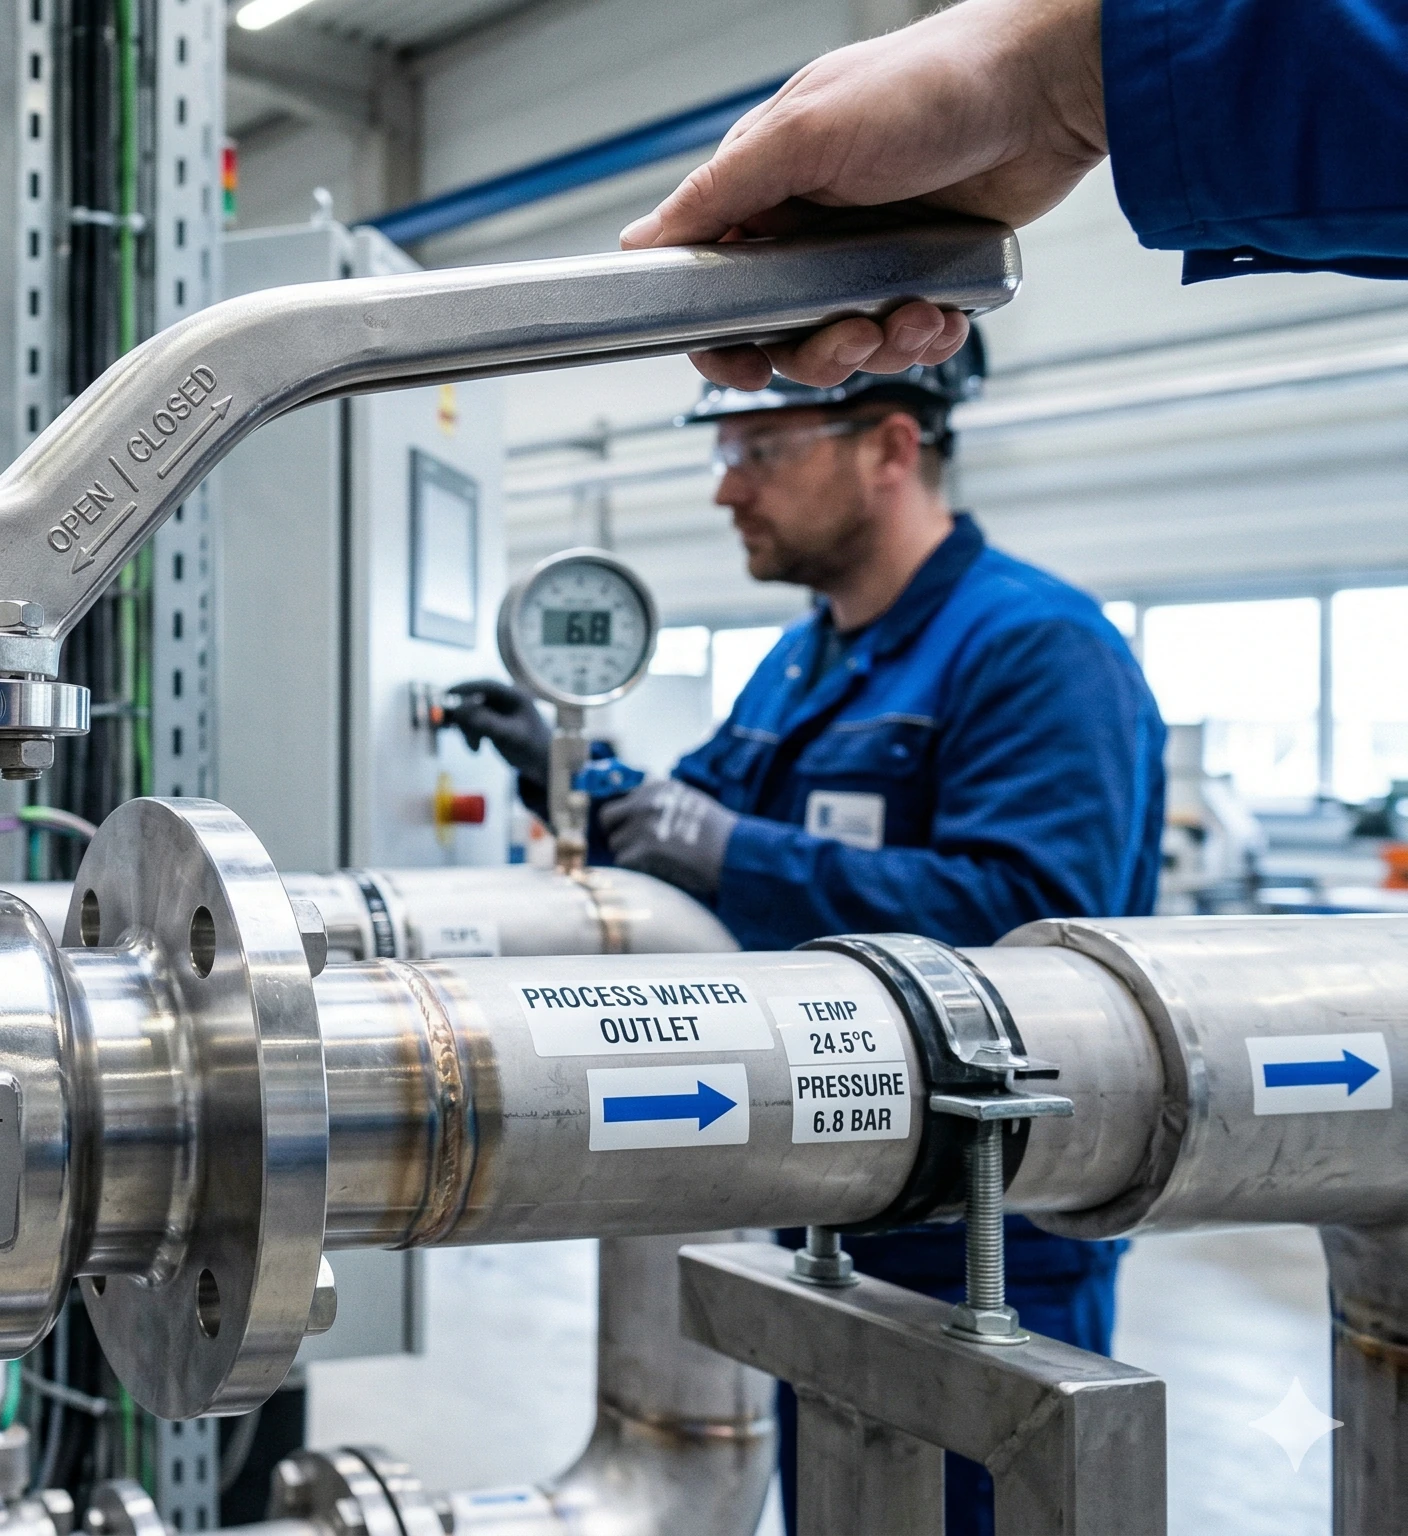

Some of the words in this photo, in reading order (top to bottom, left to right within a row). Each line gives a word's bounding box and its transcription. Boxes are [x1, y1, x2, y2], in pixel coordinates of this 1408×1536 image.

[48, 480, 115, 553] OPEN
[127, 364, 218, 462] CLOSED
[521, 985, 648, 1009] PROCESS
[649, 983, 748, 1006] WATER
[798, 1001, 858, 1022] TEMP
[599, 1016, 701, 1044] OUTLET
[809, 1030, 876, 1055] 24.5°C
[797, 1073, 905, 1099] PRESSURE
[813, 1110, 844, 1133] 6.8
[851, 1108, 891, 1131] BAR
